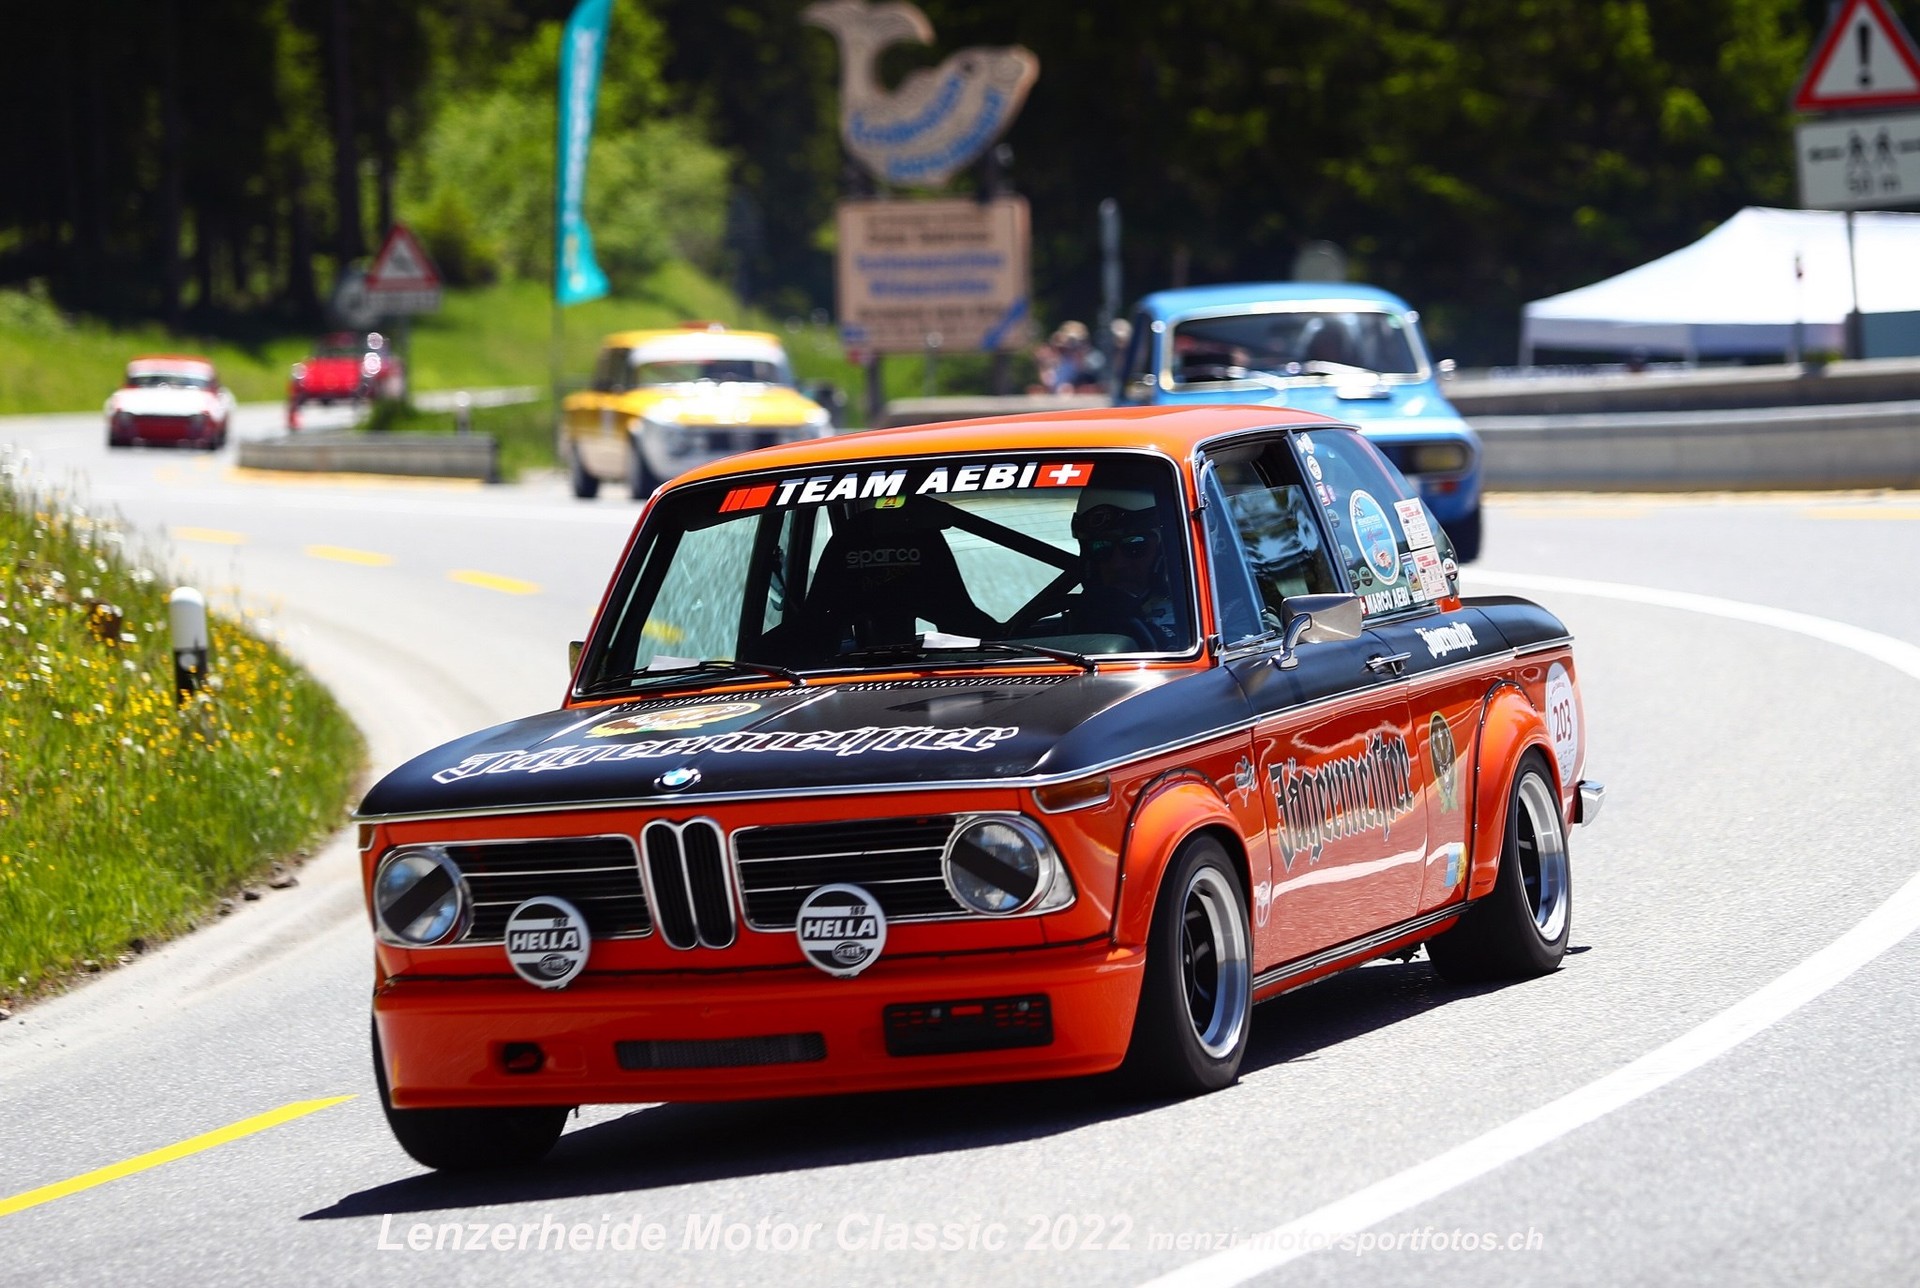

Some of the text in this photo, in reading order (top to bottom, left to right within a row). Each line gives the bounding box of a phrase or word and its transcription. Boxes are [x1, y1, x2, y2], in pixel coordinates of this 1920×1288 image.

[776, 462, 1038, 506] TEAM AEBI
[846, 548, 920, 569] sparco
[1365, 586, 1411, 615] MARCO AEBI
[1553, 699, 1572, 743] 203
[1269, 732, 1414, 873] Jägermeister
[512, 929, 578, 951] HELLA
[803, 917, 876, 938] HELLA
